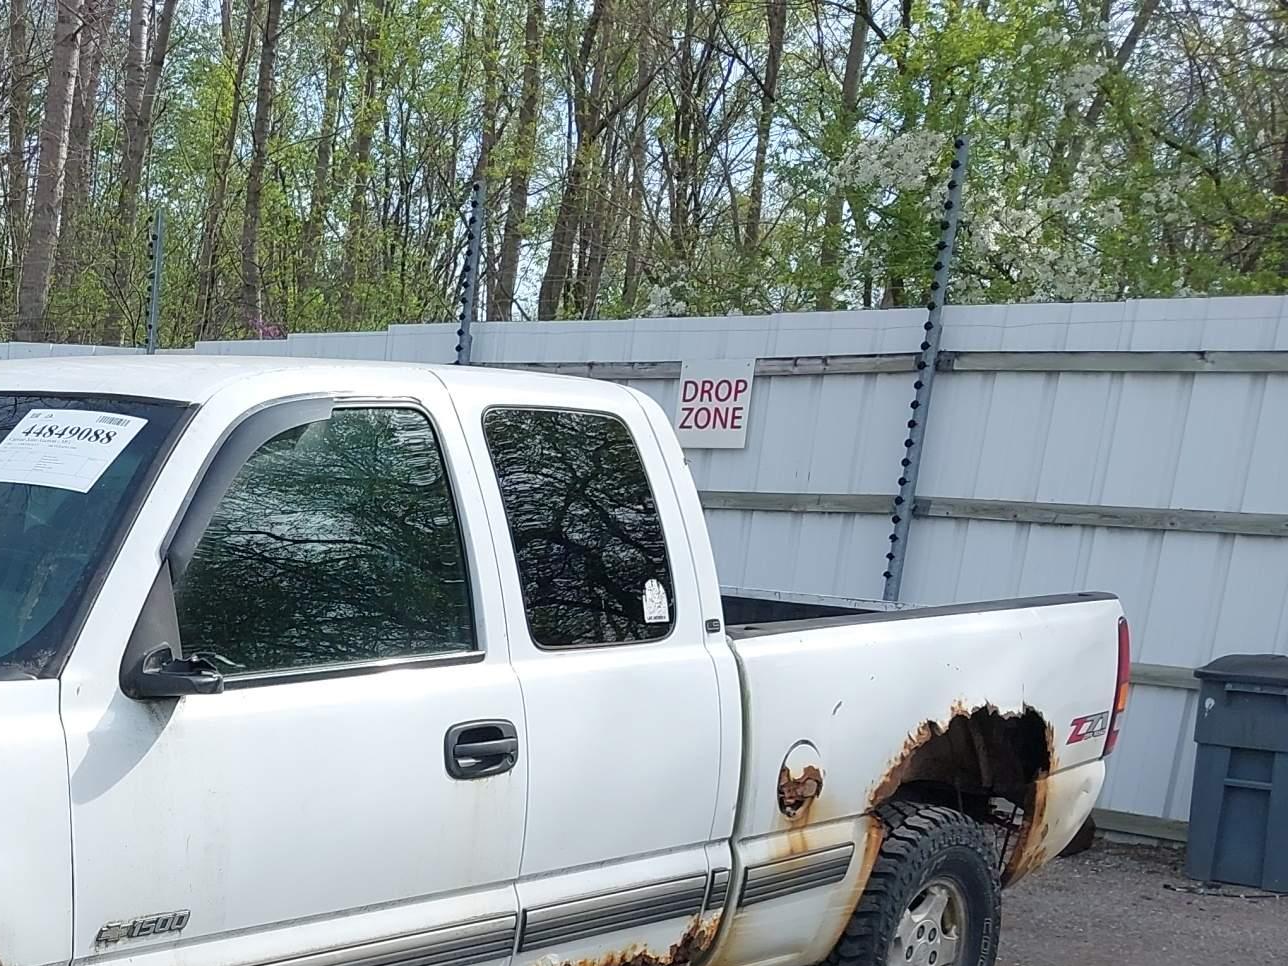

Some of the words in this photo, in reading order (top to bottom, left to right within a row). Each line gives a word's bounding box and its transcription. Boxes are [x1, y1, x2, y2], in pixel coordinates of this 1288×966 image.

[682, 379, 748, 403] DROP
[679, 406, 744, 430] ZONE
[21, 423, 117, 445] 44849088
[1066, 711, 1110, 745] Z71
[132, 912, 189, 937] 1500
